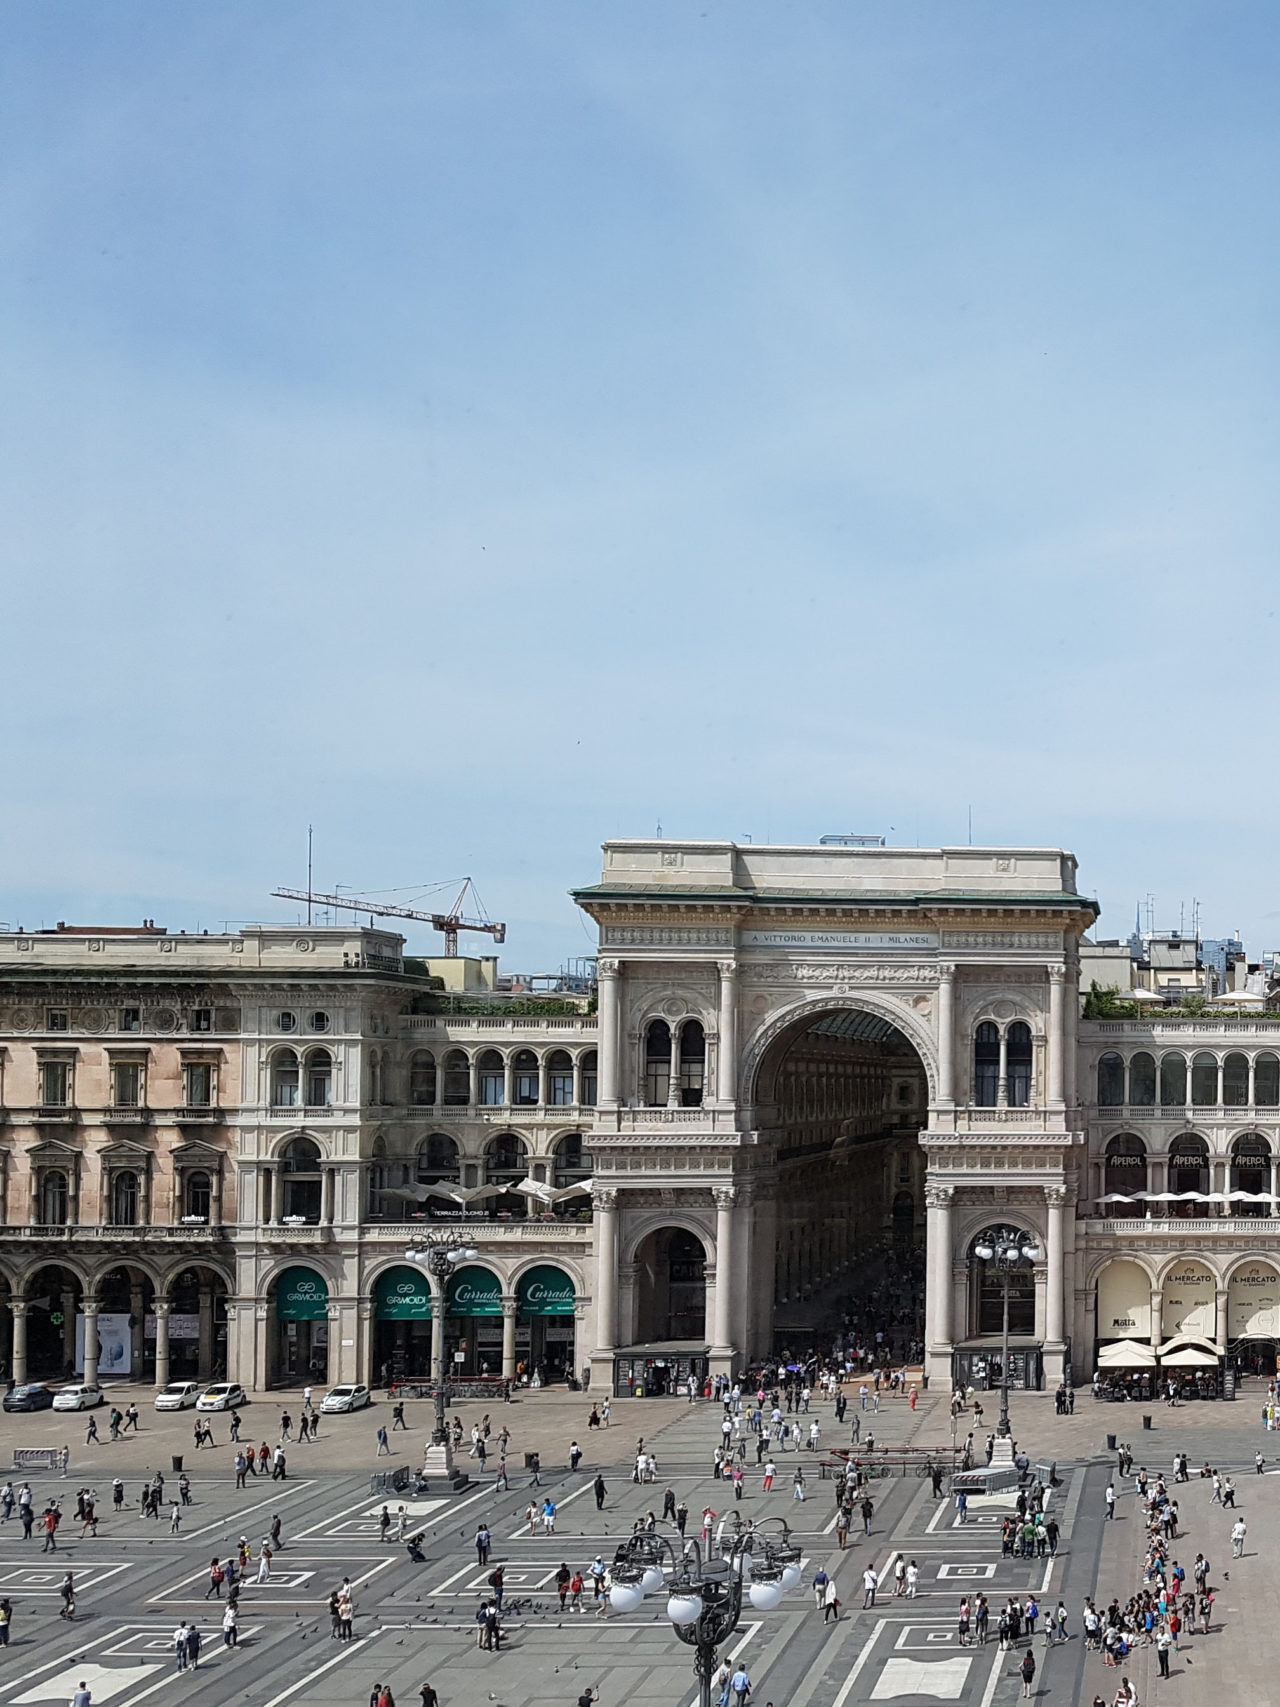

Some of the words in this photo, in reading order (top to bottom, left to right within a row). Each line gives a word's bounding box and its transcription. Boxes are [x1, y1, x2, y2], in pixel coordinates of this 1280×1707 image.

[763, 935, 806, 943] VITTORIO
[810, 935, 860, 943] EMANUELE
[888, 936, 929, 944] MILANESI
[1111, 1155, 1142, 1166] APEROL
[1173, 1155, 1204, 1166] APEROL
[1235, 1155, 1266, 1165] APEROL
[287, 1293, 325, 1301] GRIMOLDI
[527, 1283, 573, 1302] Currado
[386, 1296, 426, 1304] GRIMOLDI
